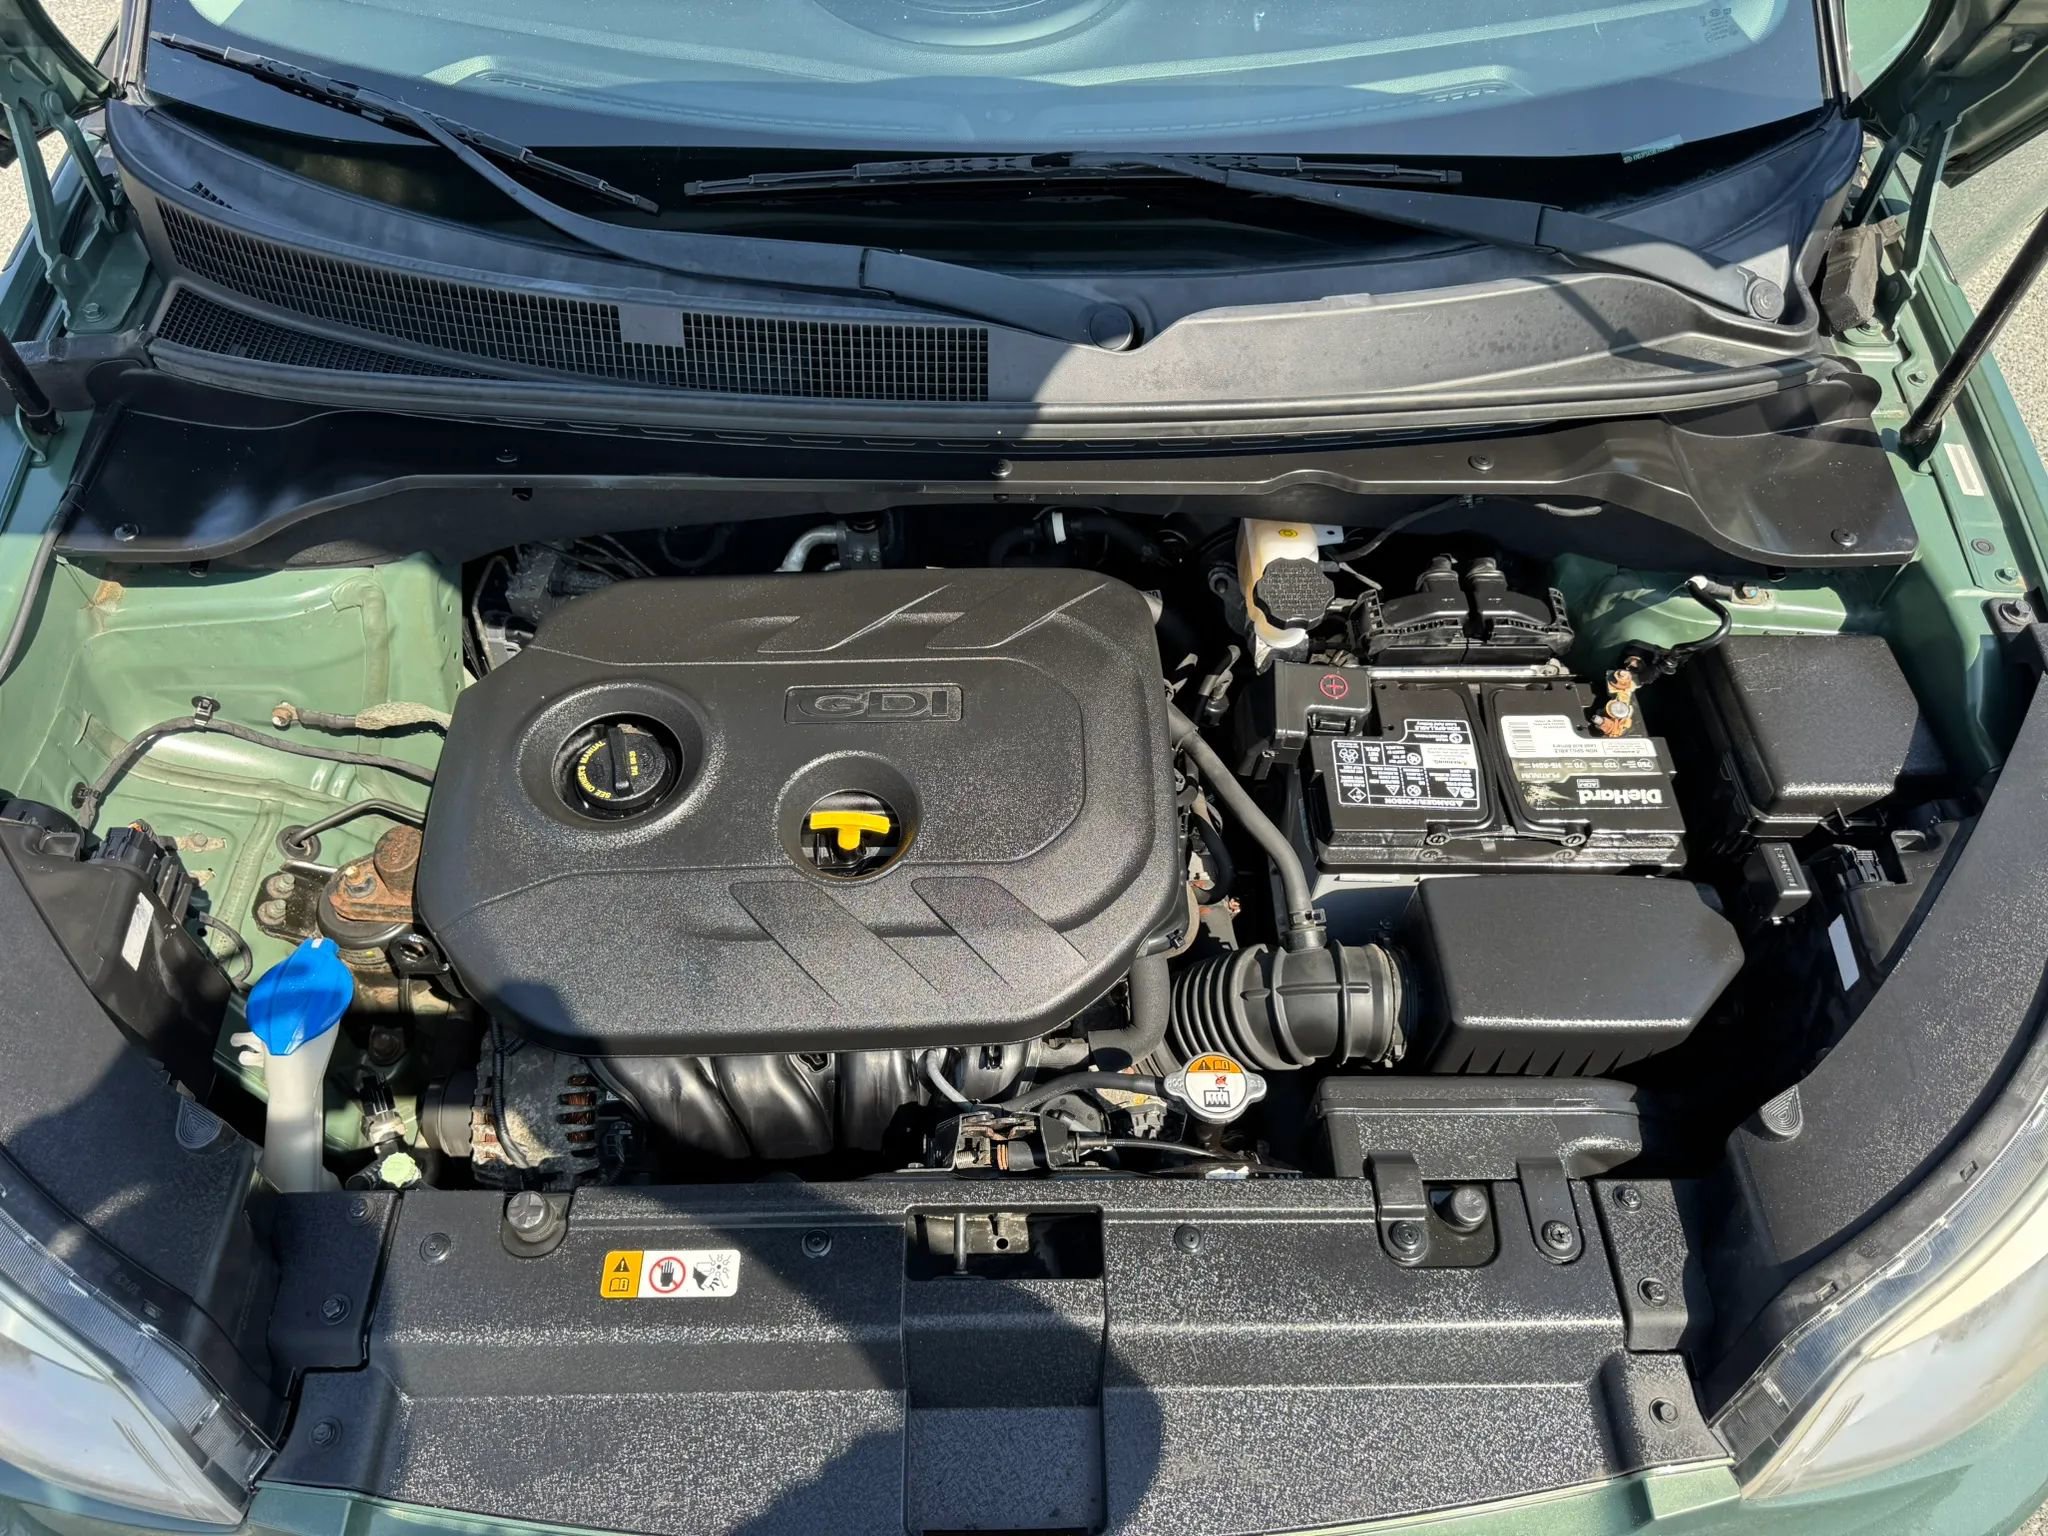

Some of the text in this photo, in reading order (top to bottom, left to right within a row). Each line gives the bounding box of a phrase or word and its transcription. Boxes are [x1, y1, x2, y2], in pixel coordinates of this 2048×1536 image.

[796, 689, 948, 718] GDI
[577, 740, 612, 799] SEE OWNER'S MANUAL
[1579, 789, 1663, 804] DieHard
